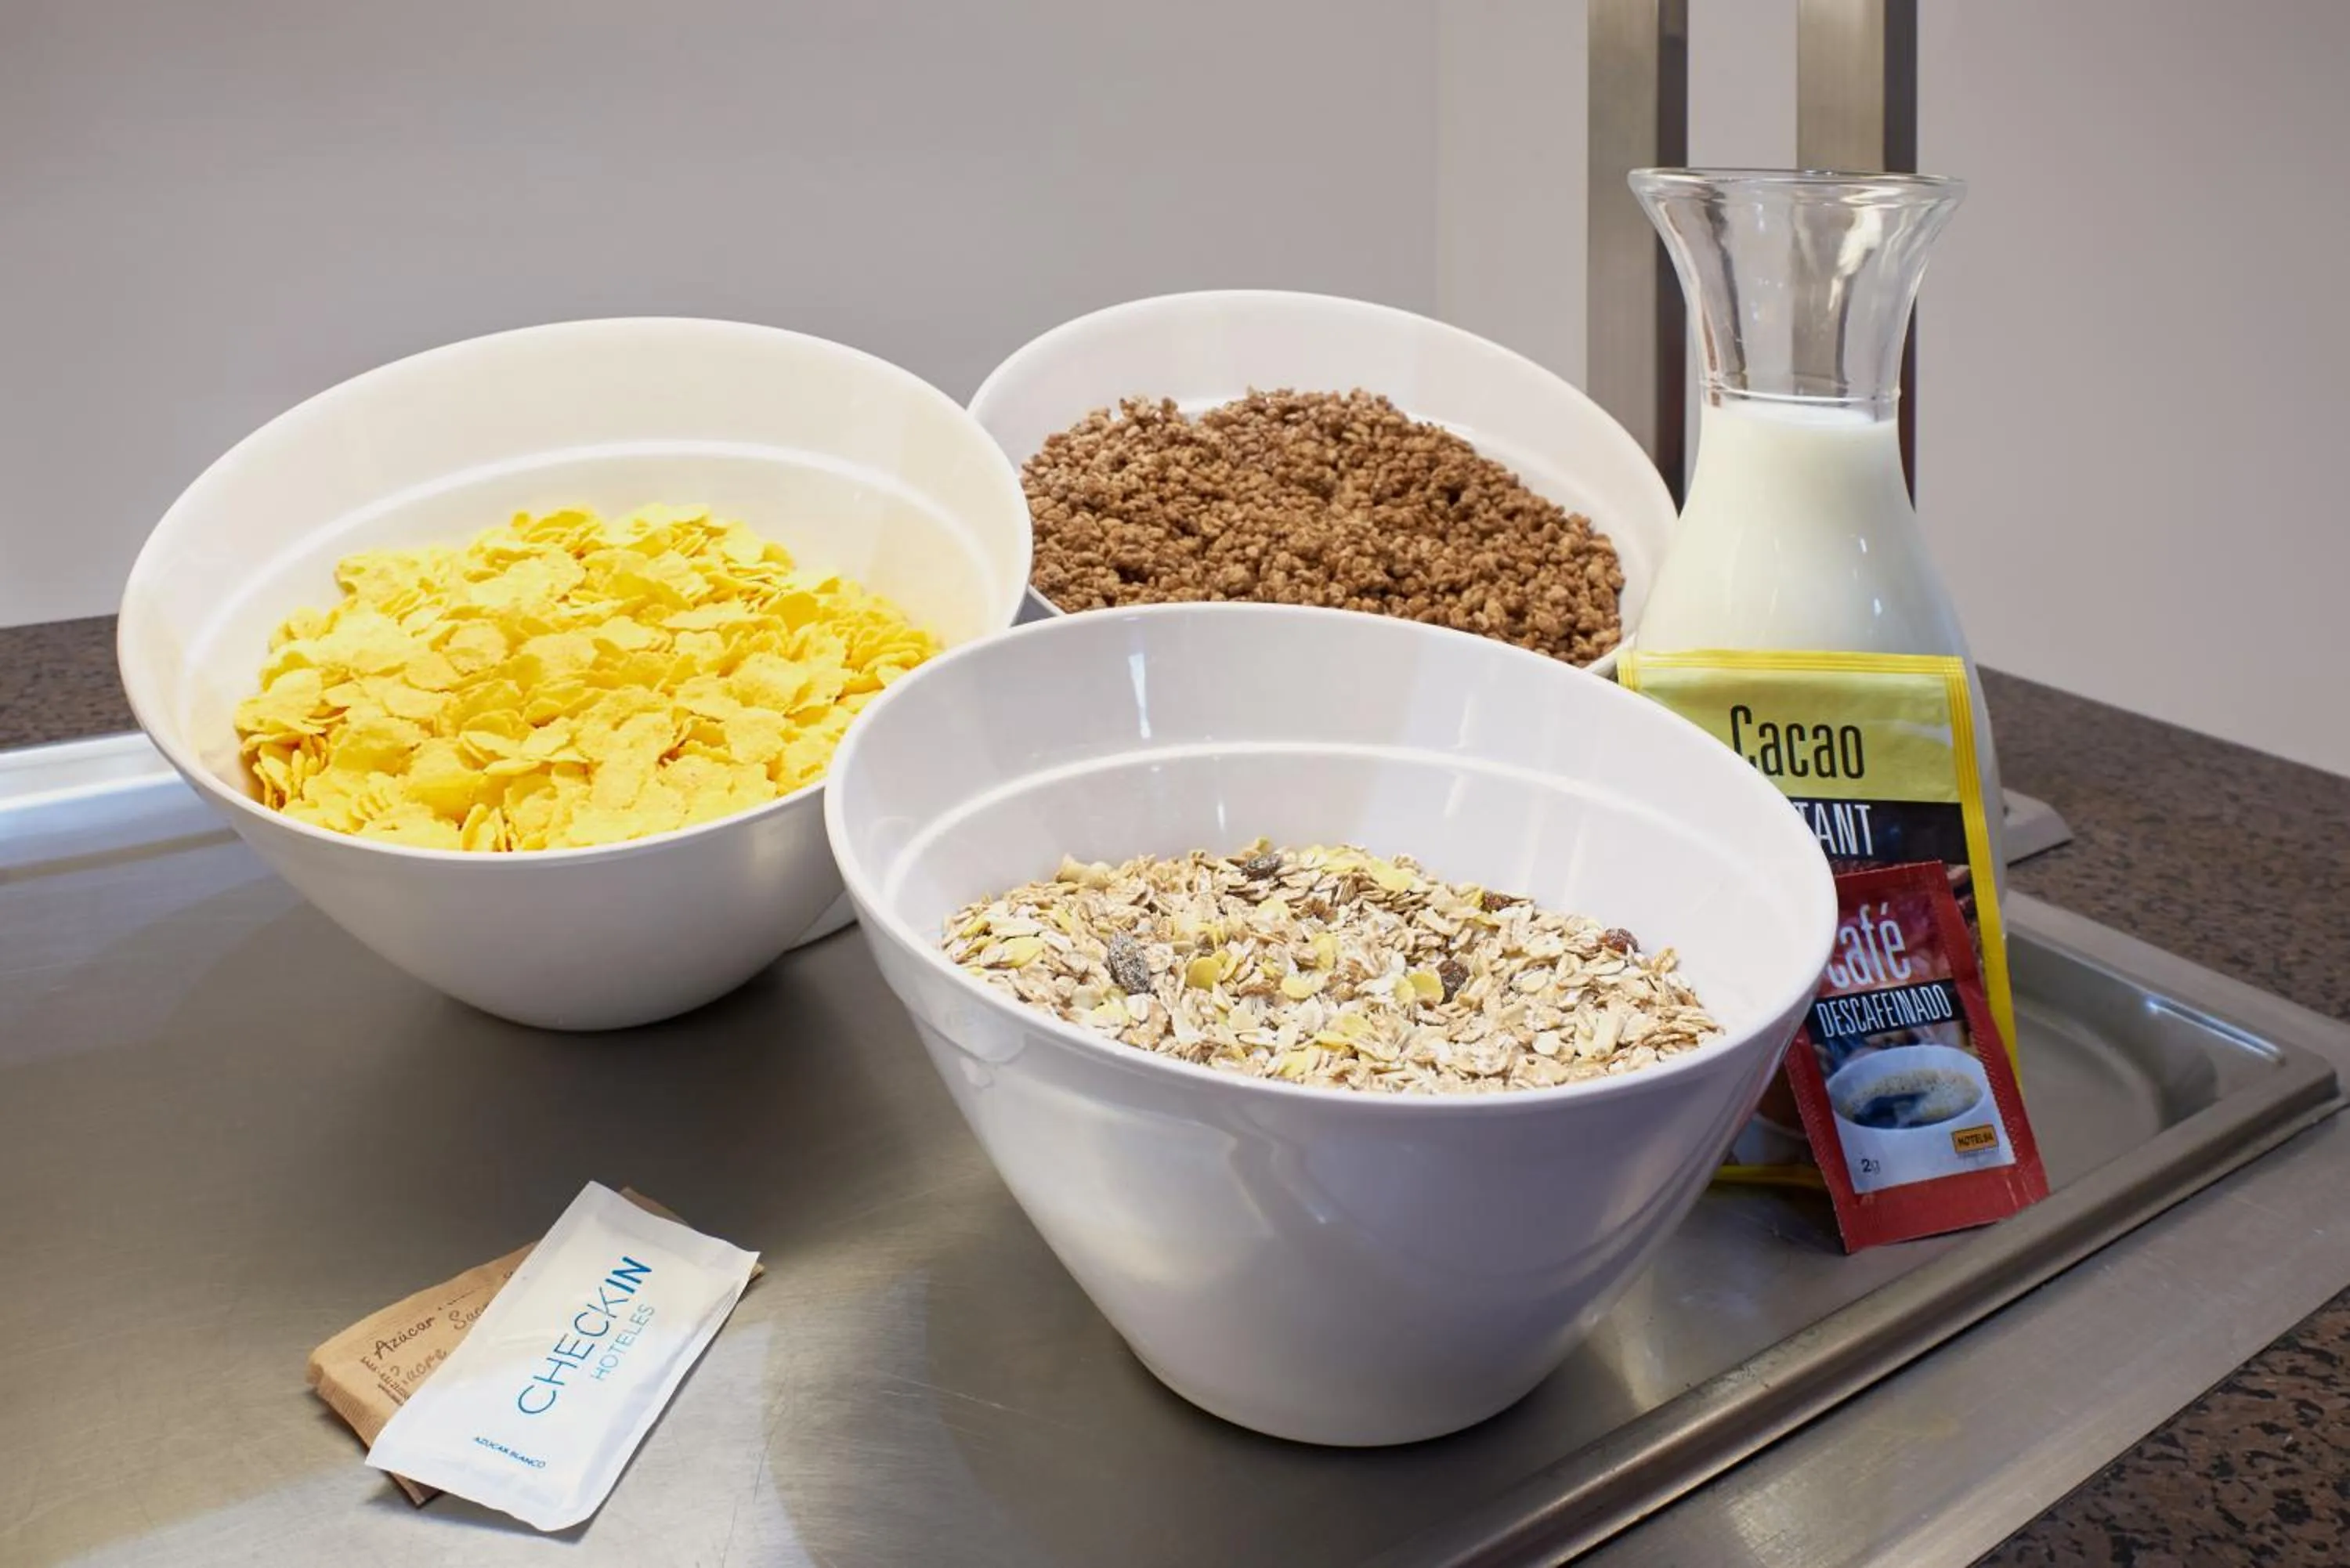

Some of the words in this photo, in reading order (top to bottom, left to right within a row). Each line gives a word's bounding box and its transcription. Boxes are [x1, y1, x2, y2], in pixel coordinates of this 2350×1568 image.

[1730, 704, 1865, 779] Cacao
[1816, 984, 1953, 1038] DESCAFEINADO
[518, 1255, 653, 1414] CHECKIN
[591, 1303, 656, 1381] HOTELES
